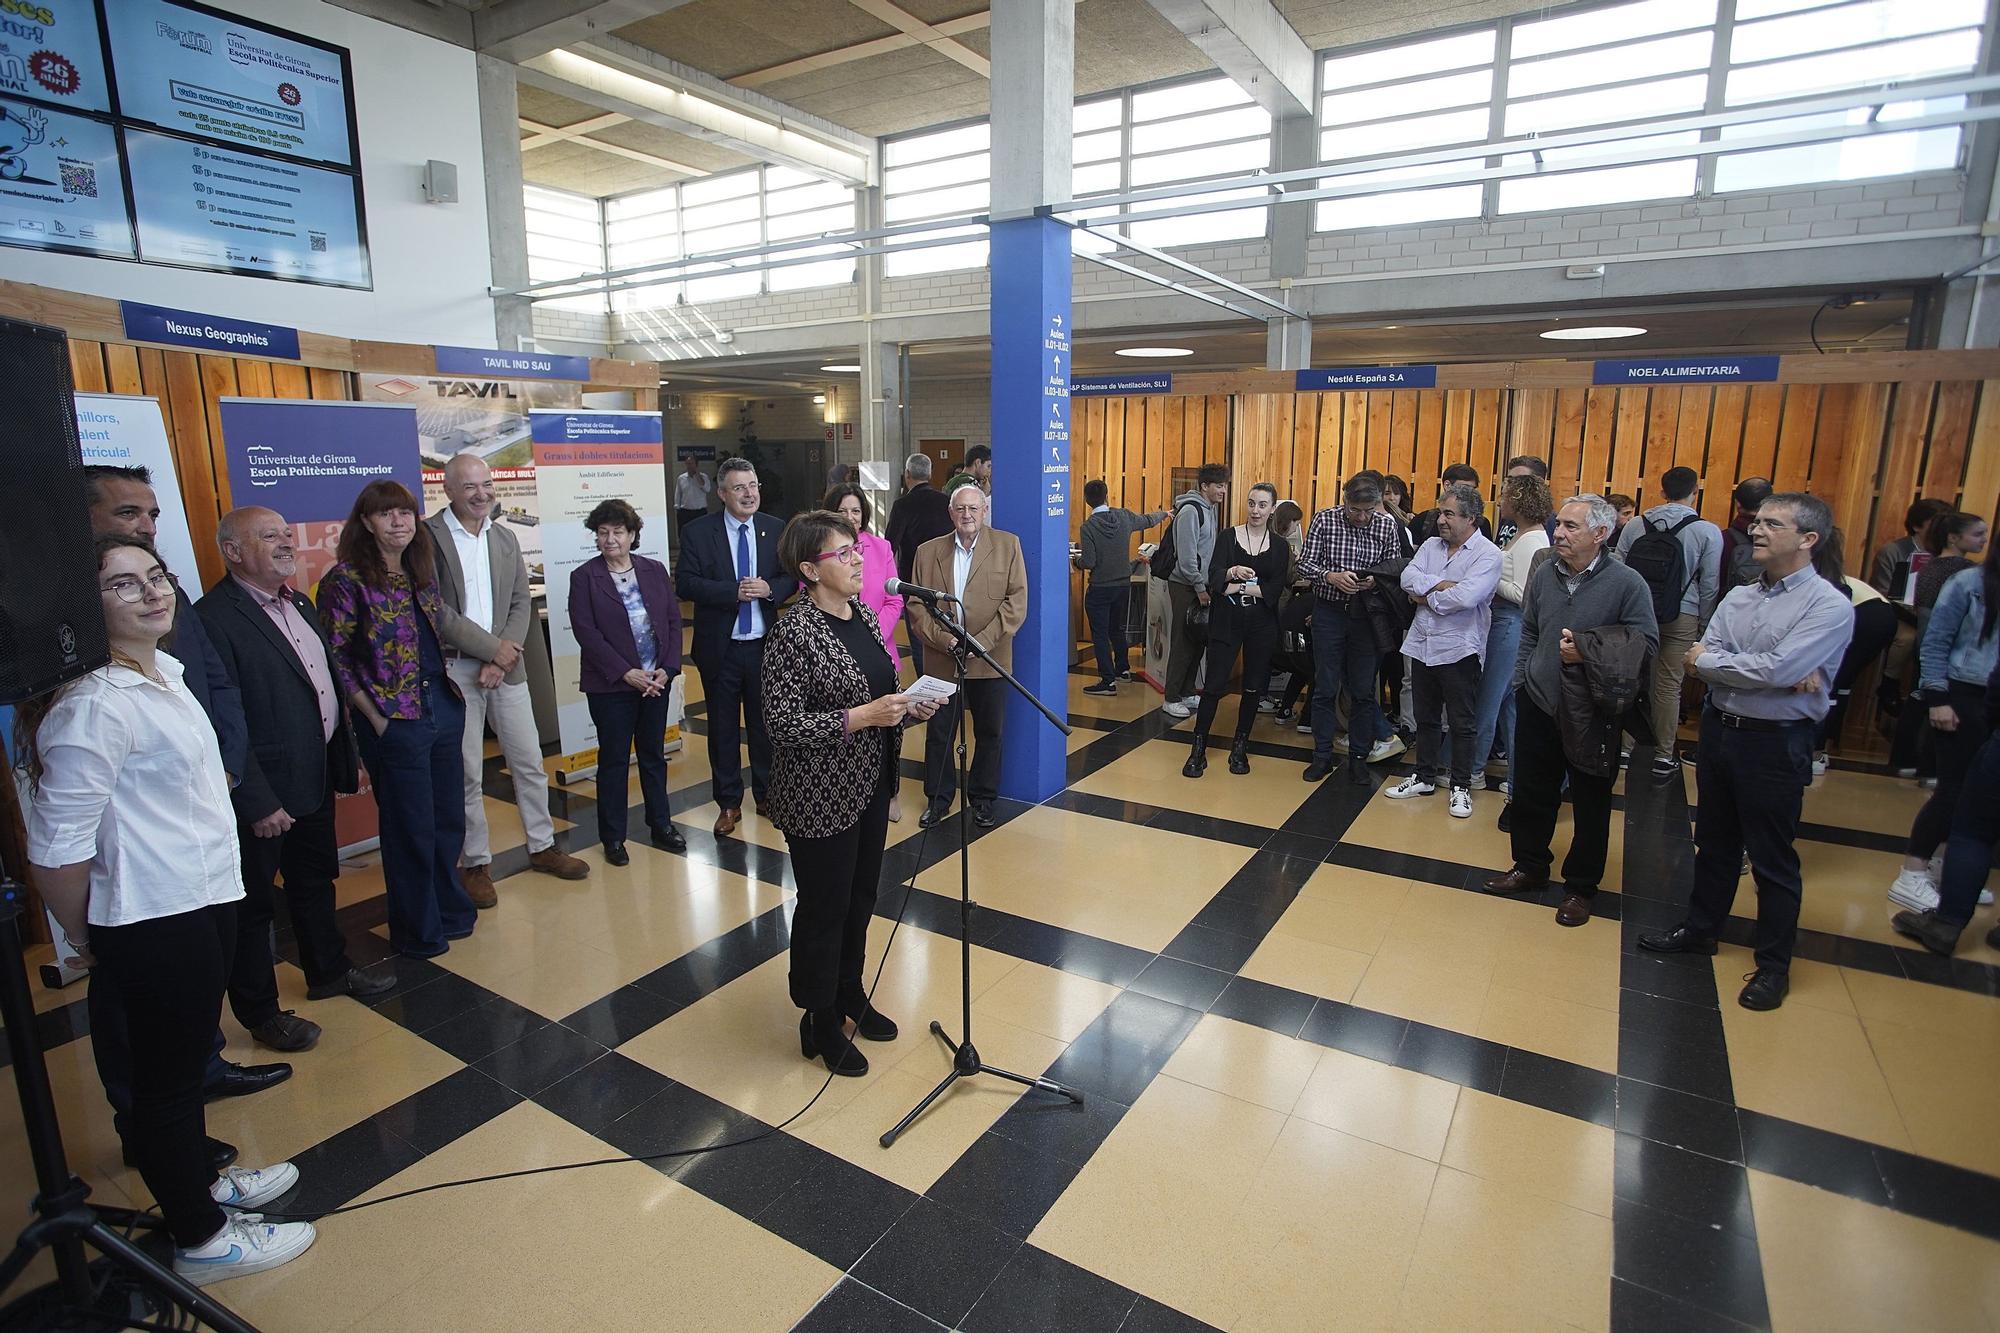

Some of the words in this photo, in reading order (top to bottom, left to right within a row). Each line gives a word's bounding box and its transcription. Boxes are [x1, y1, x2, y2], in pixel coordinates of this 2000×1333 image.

[227, 38, 272, 58] Universitat
[274, 50, 284, 60] de
[285, 54, 311, 69] Girona
[41, 59, 69, 78] 26
[229, 48, 257, 63] Escola
[258, 57, 304, 75] Politècnica
[305, 69, 340, 85] Superior
[40, 73, 69, 88] abril
[166, 320, 202, 337] Nexus
[204, 326, 269, 346] Geographics
[1050, 329, 1065, 340] Aules
[483, 357, 511, 369] TAVIL
[513, 360, 530, 370] IND
[531, 362, 551, 371] SAU
[1628, 368, 1659, 377] NOEL
[1661, 366, 1741, 376] ALIMENTARIA
[1050, 375, 1065, 386] Aules
[1327, 375, 1354, 384] Nestlé
[1355, 374, 1387, 384] España
[428, 381, 517, 399] TAVIL
[1117, 381, 1153, 389] Ventilación,
[1049, 420, 1064, 430] Aules
[248, 455, 307, 465] Universitat
[309, 455, 321, 464] de
[323, 454, 356, 464] Girona
[544, 452, 573, 461] Graus
[579, 450, 607, 460] dobles
[609, 450, 654, 460] titulacions
[250, 467, 287, 477] Escola
[288, 465, 348, 477] Politècnica
[349, 464, 393, 477] Superior
[1043, 464, 1069, 473] Laboratoris
[1048, 494, 1064, 503] Edifici
[1048, 507, 1064, 517] Tallers
